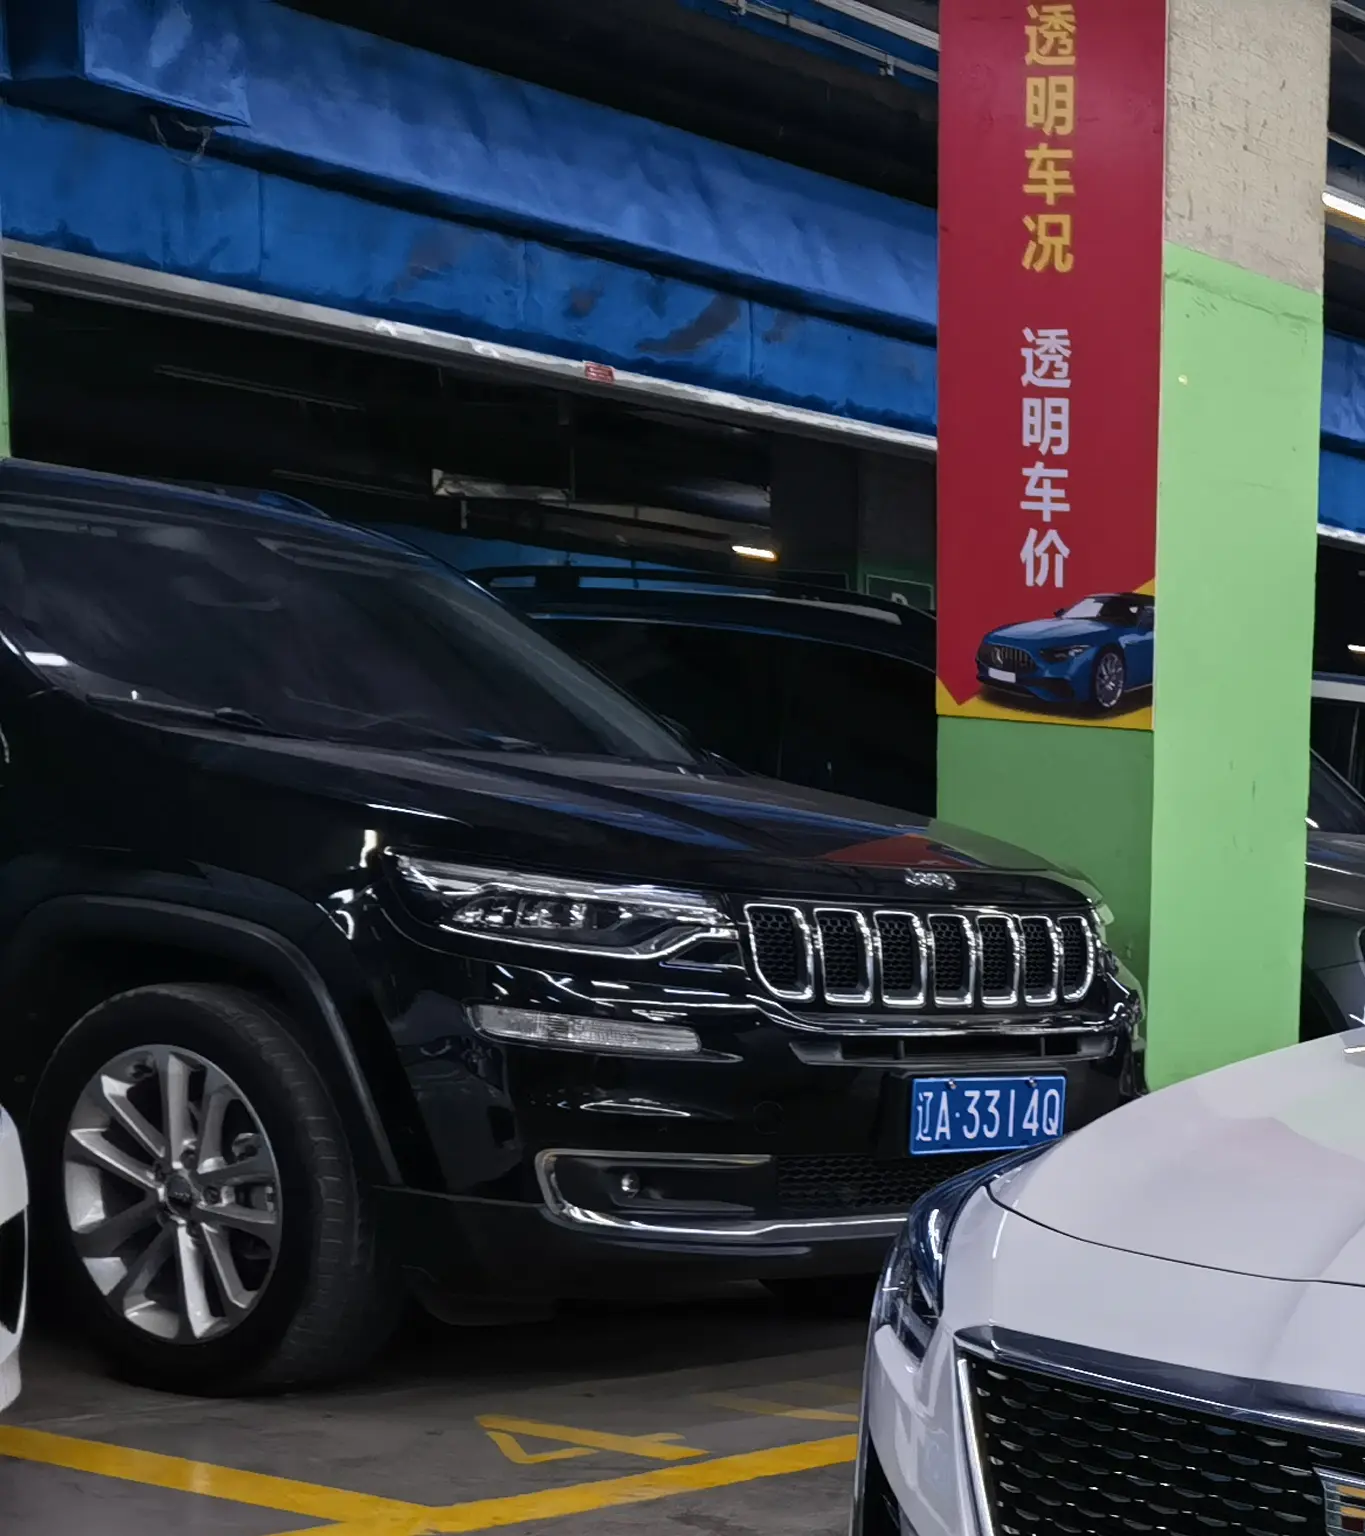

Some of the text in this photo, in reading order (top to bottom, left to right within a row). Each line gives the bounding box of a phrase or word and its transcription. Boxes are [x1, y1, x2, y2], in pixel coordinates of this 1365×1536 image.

[1022, 4, 1077, 273] 透明车况
[1020, 326, 1072, 588] 透明车价
